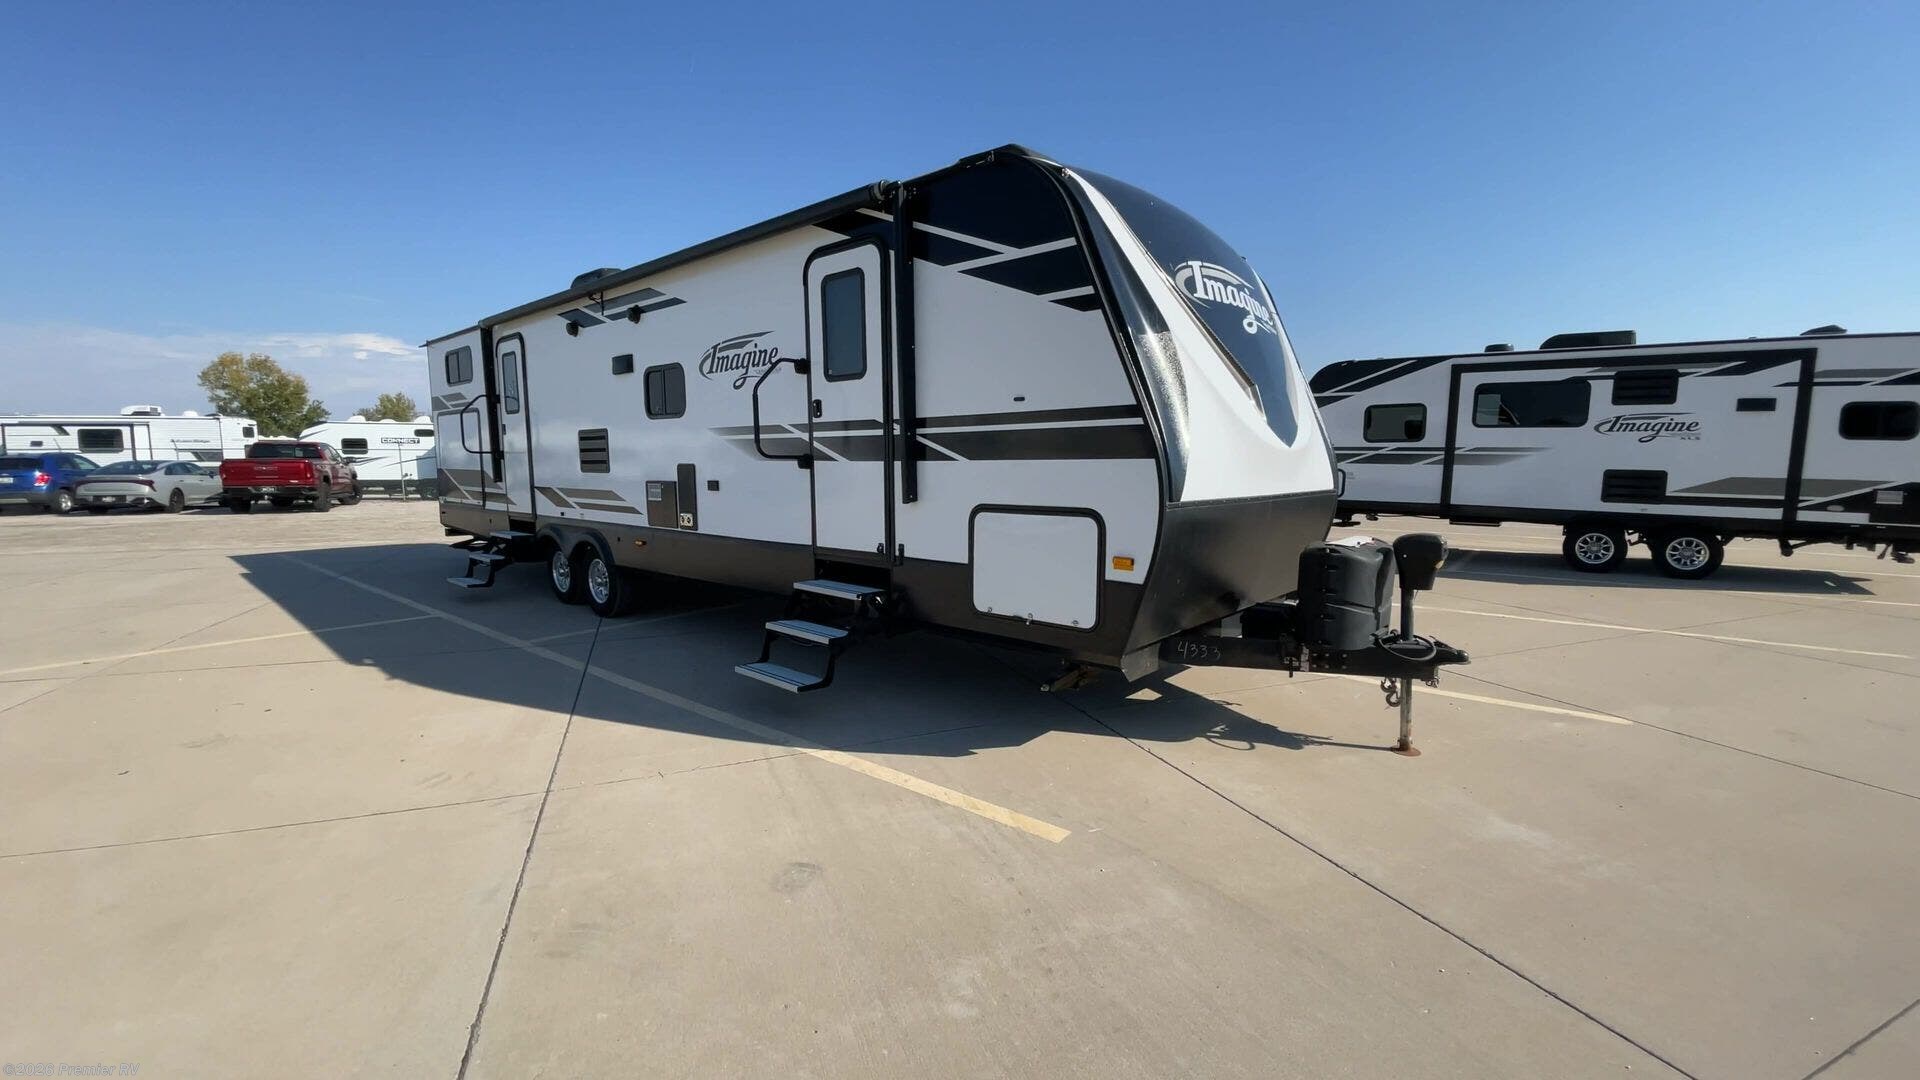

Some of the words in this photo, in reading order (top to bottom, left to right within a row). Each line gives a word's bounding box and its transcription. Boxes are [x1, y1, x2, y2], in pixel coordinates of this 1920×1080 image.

[1186, 260, 1274, 334] Imagine
[705, 342, 778, 390] Imagine
[1602, 415, 1699, 442] Imagine
[1177, 640, 1221, 660] 4333
